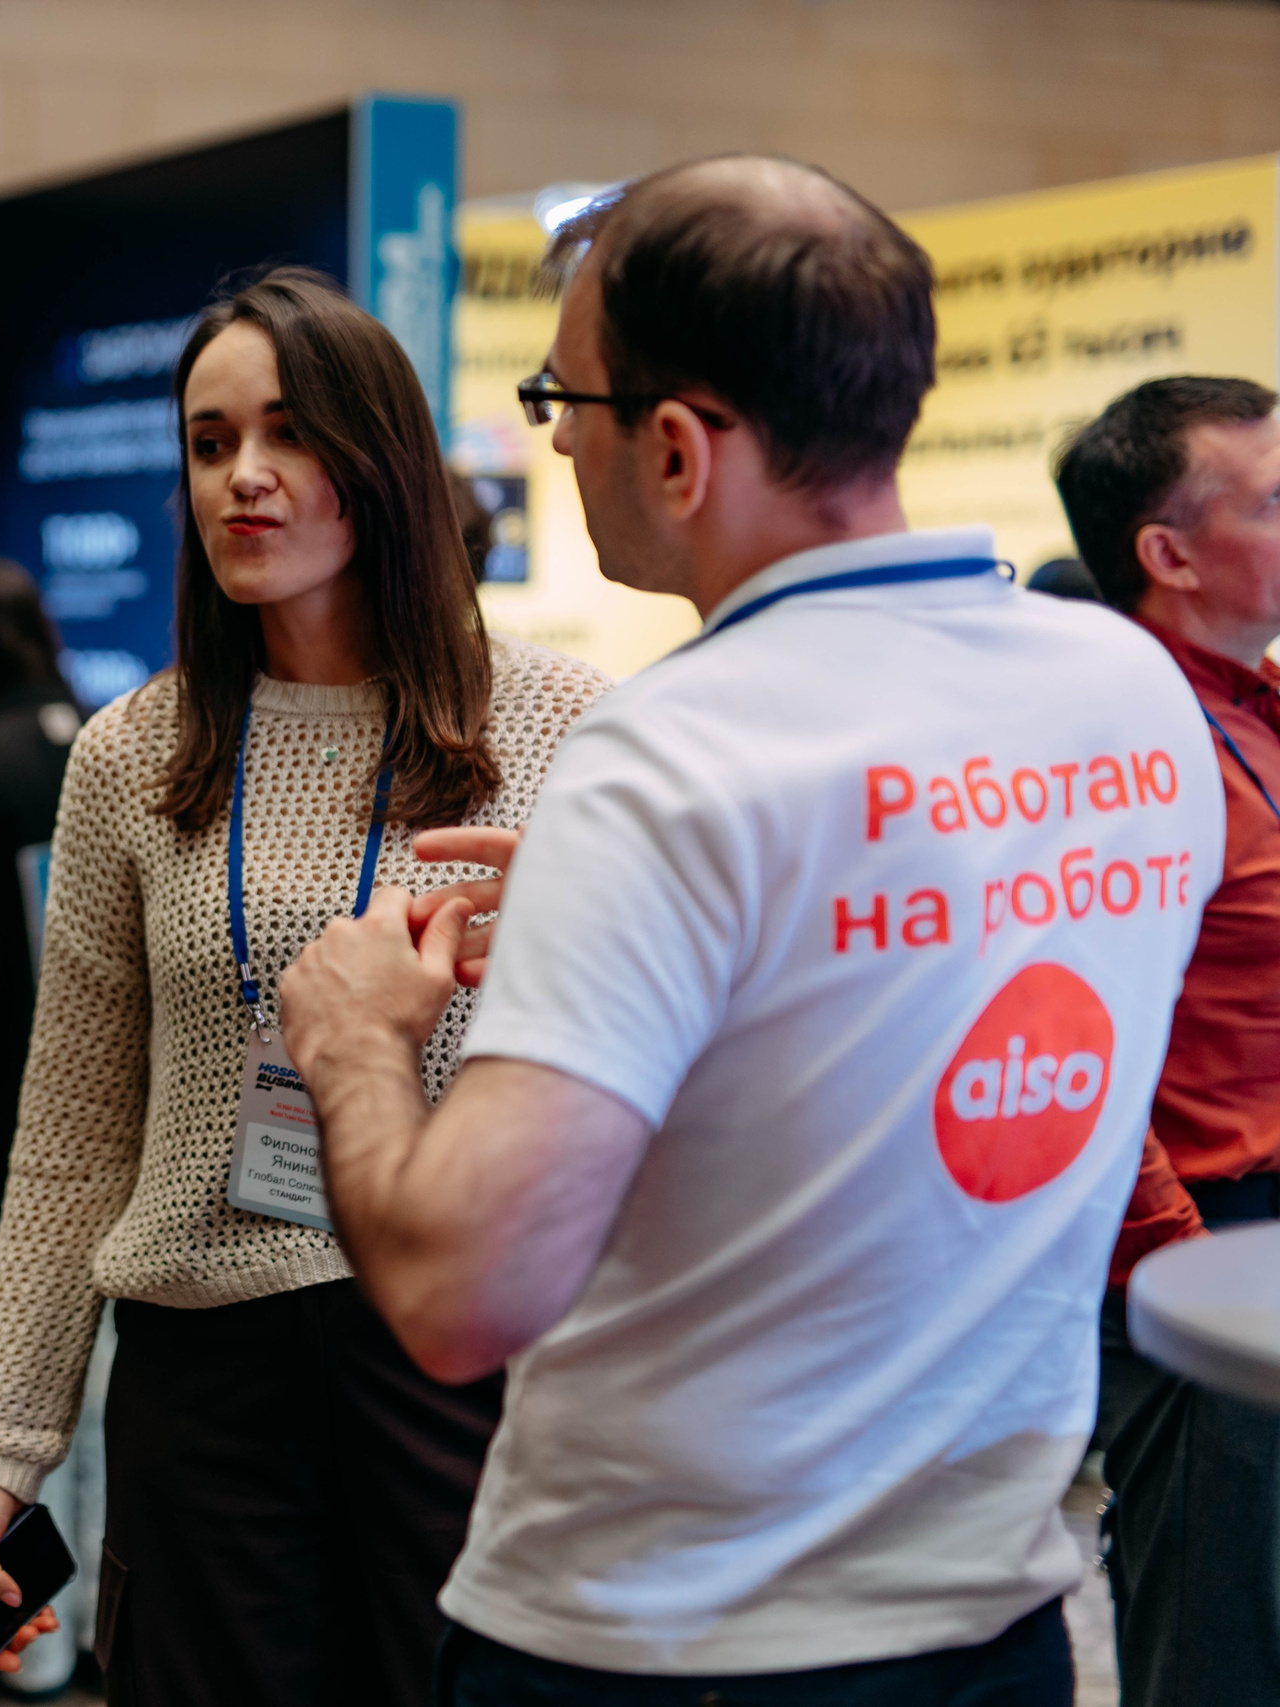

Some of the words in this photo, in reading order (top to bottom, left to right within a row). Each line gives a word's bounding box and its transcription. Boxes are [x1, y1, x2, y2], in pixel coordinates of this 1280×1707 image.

[864, 749, 1179, 843] Работаю
[831, 888, 952, 955] на
[257, 1073, 307, 1092] BUSINE
[258, 1062, 300, 1080] HOSPI
[949, 1034, 1105, 1122] aiso
[271, 1154, 317, 1176] Янина
[248, 1168, 286, 1186] Глобал
[288, 1178, 324, 1195] Солюш
[269, 1188, 313, 1204] СТАНДАРТ
